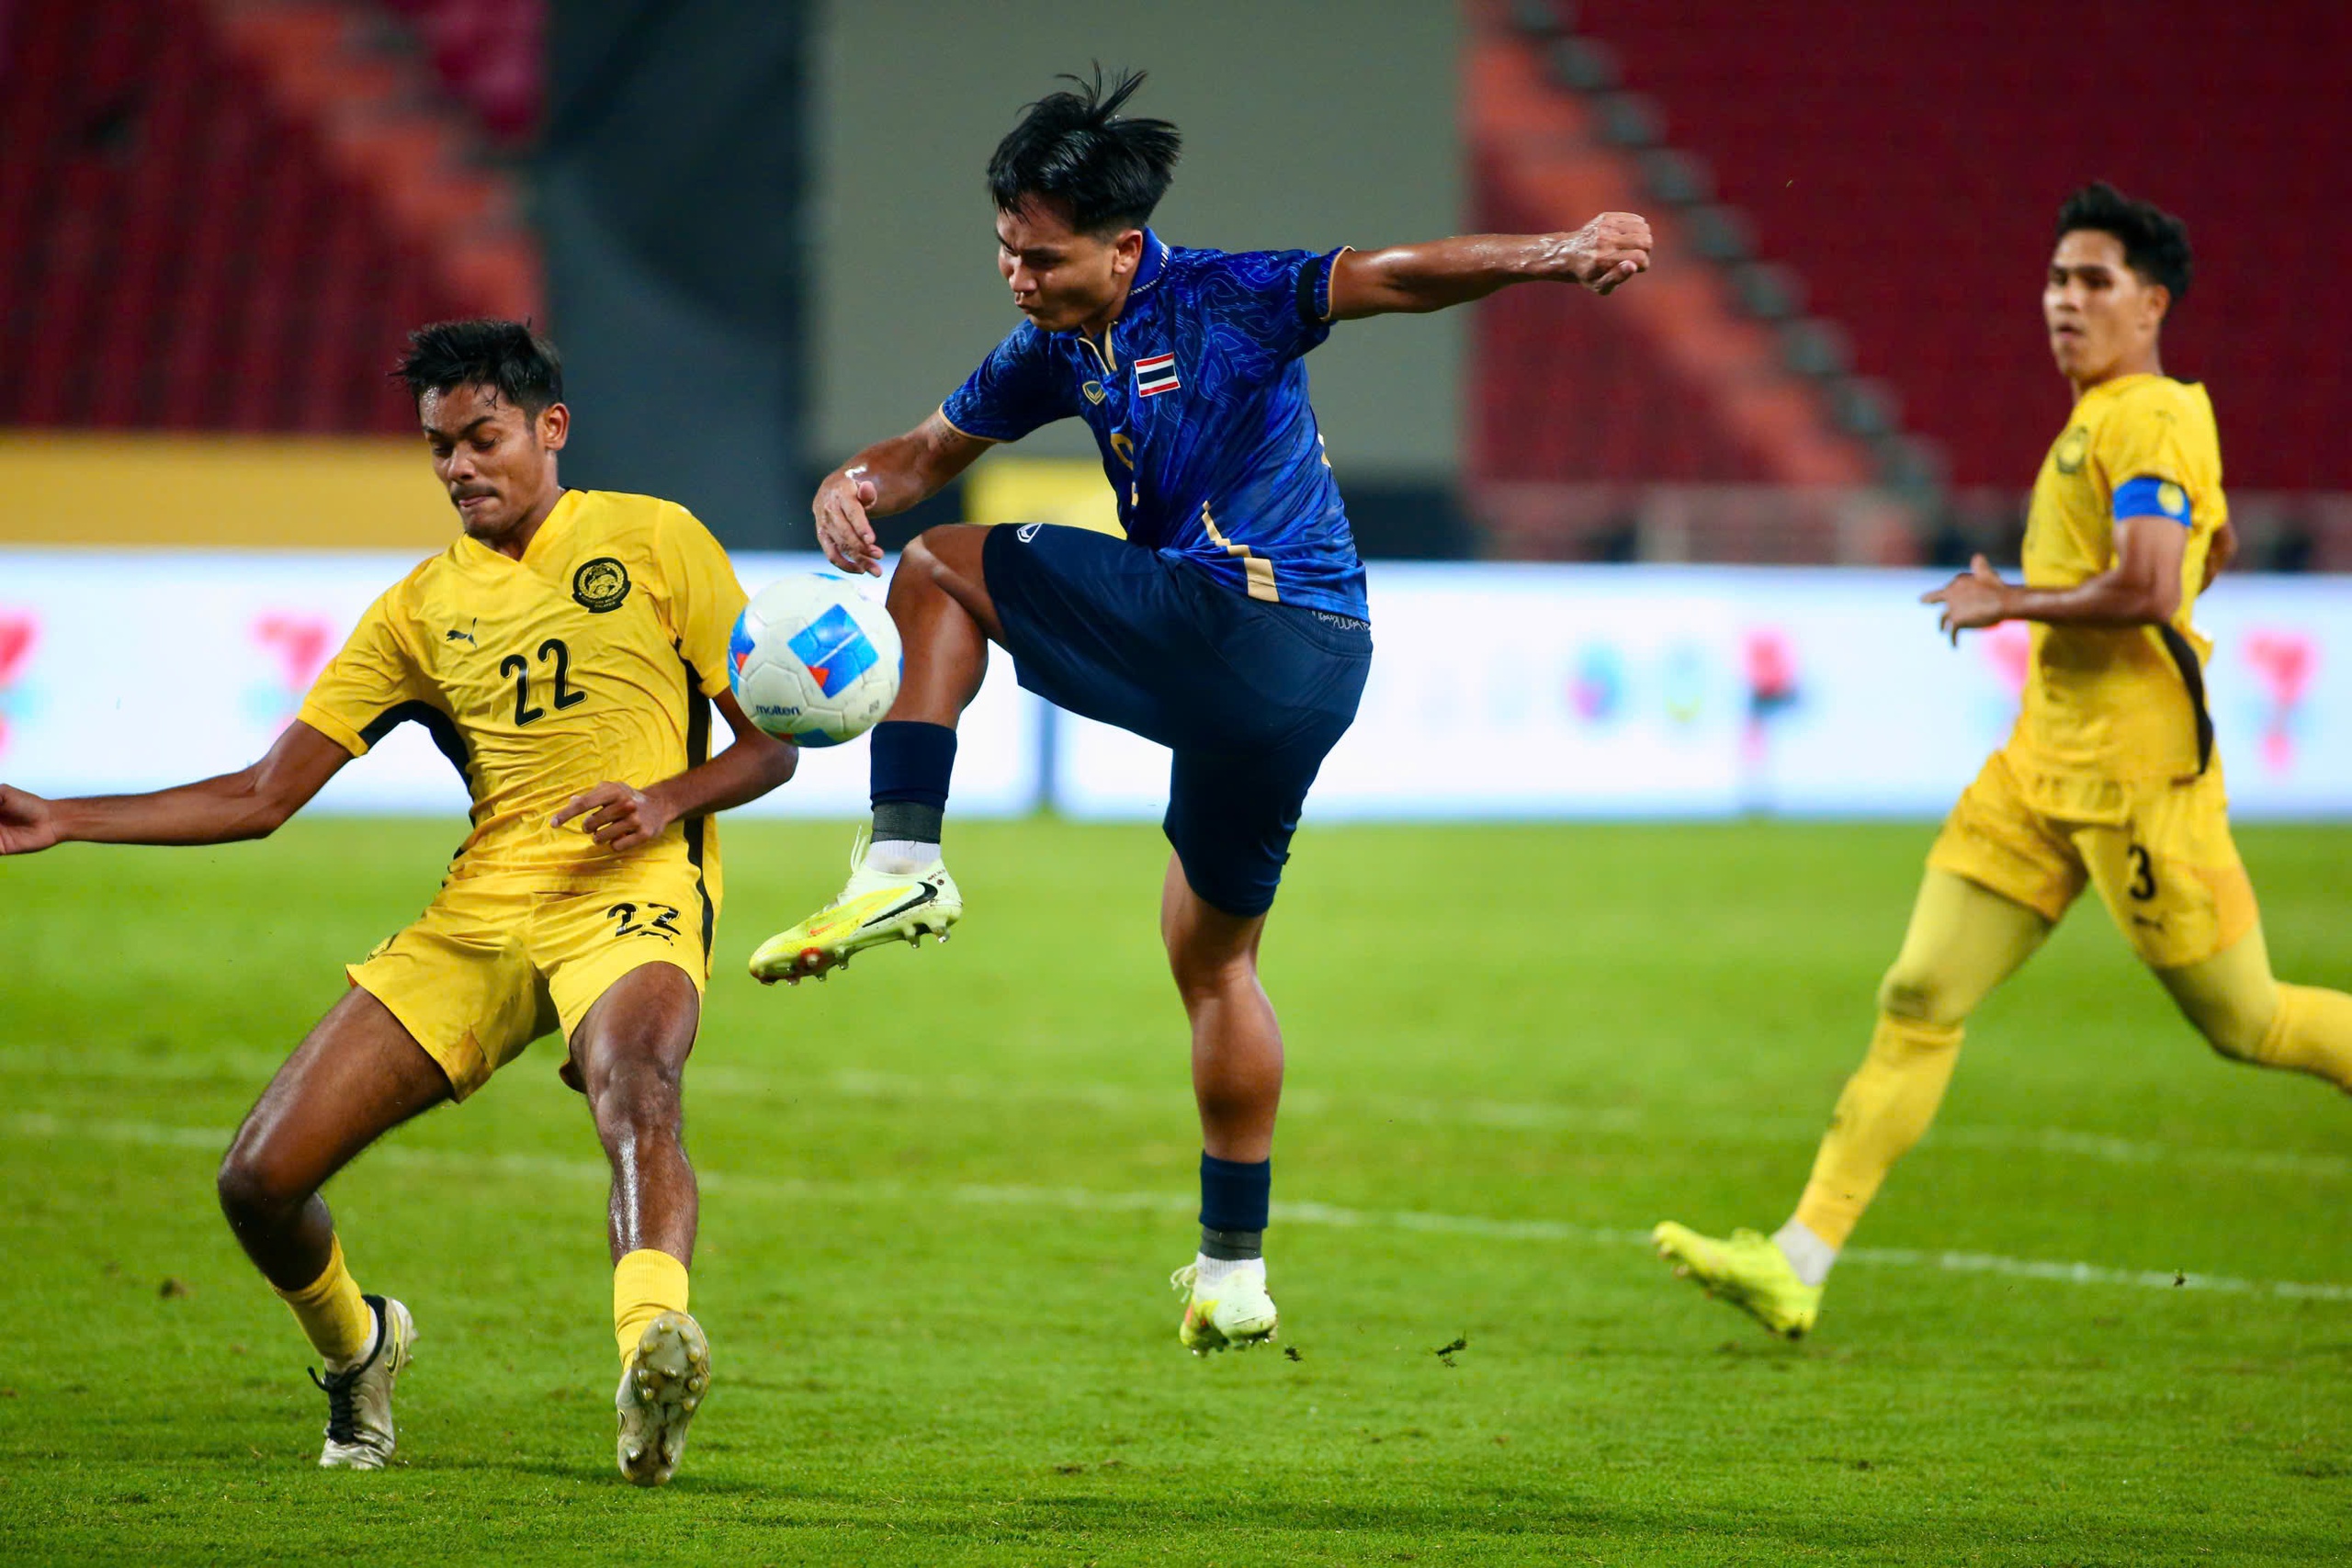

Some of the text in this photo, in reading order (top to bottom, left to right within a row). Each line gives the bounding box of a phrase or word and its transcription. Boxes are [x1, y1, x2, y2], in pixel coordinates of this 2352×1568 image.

[500, 636, 587, 727] 22
[755, 705, 801, 716] molten
[2128, 844, 2155, 901] 3
